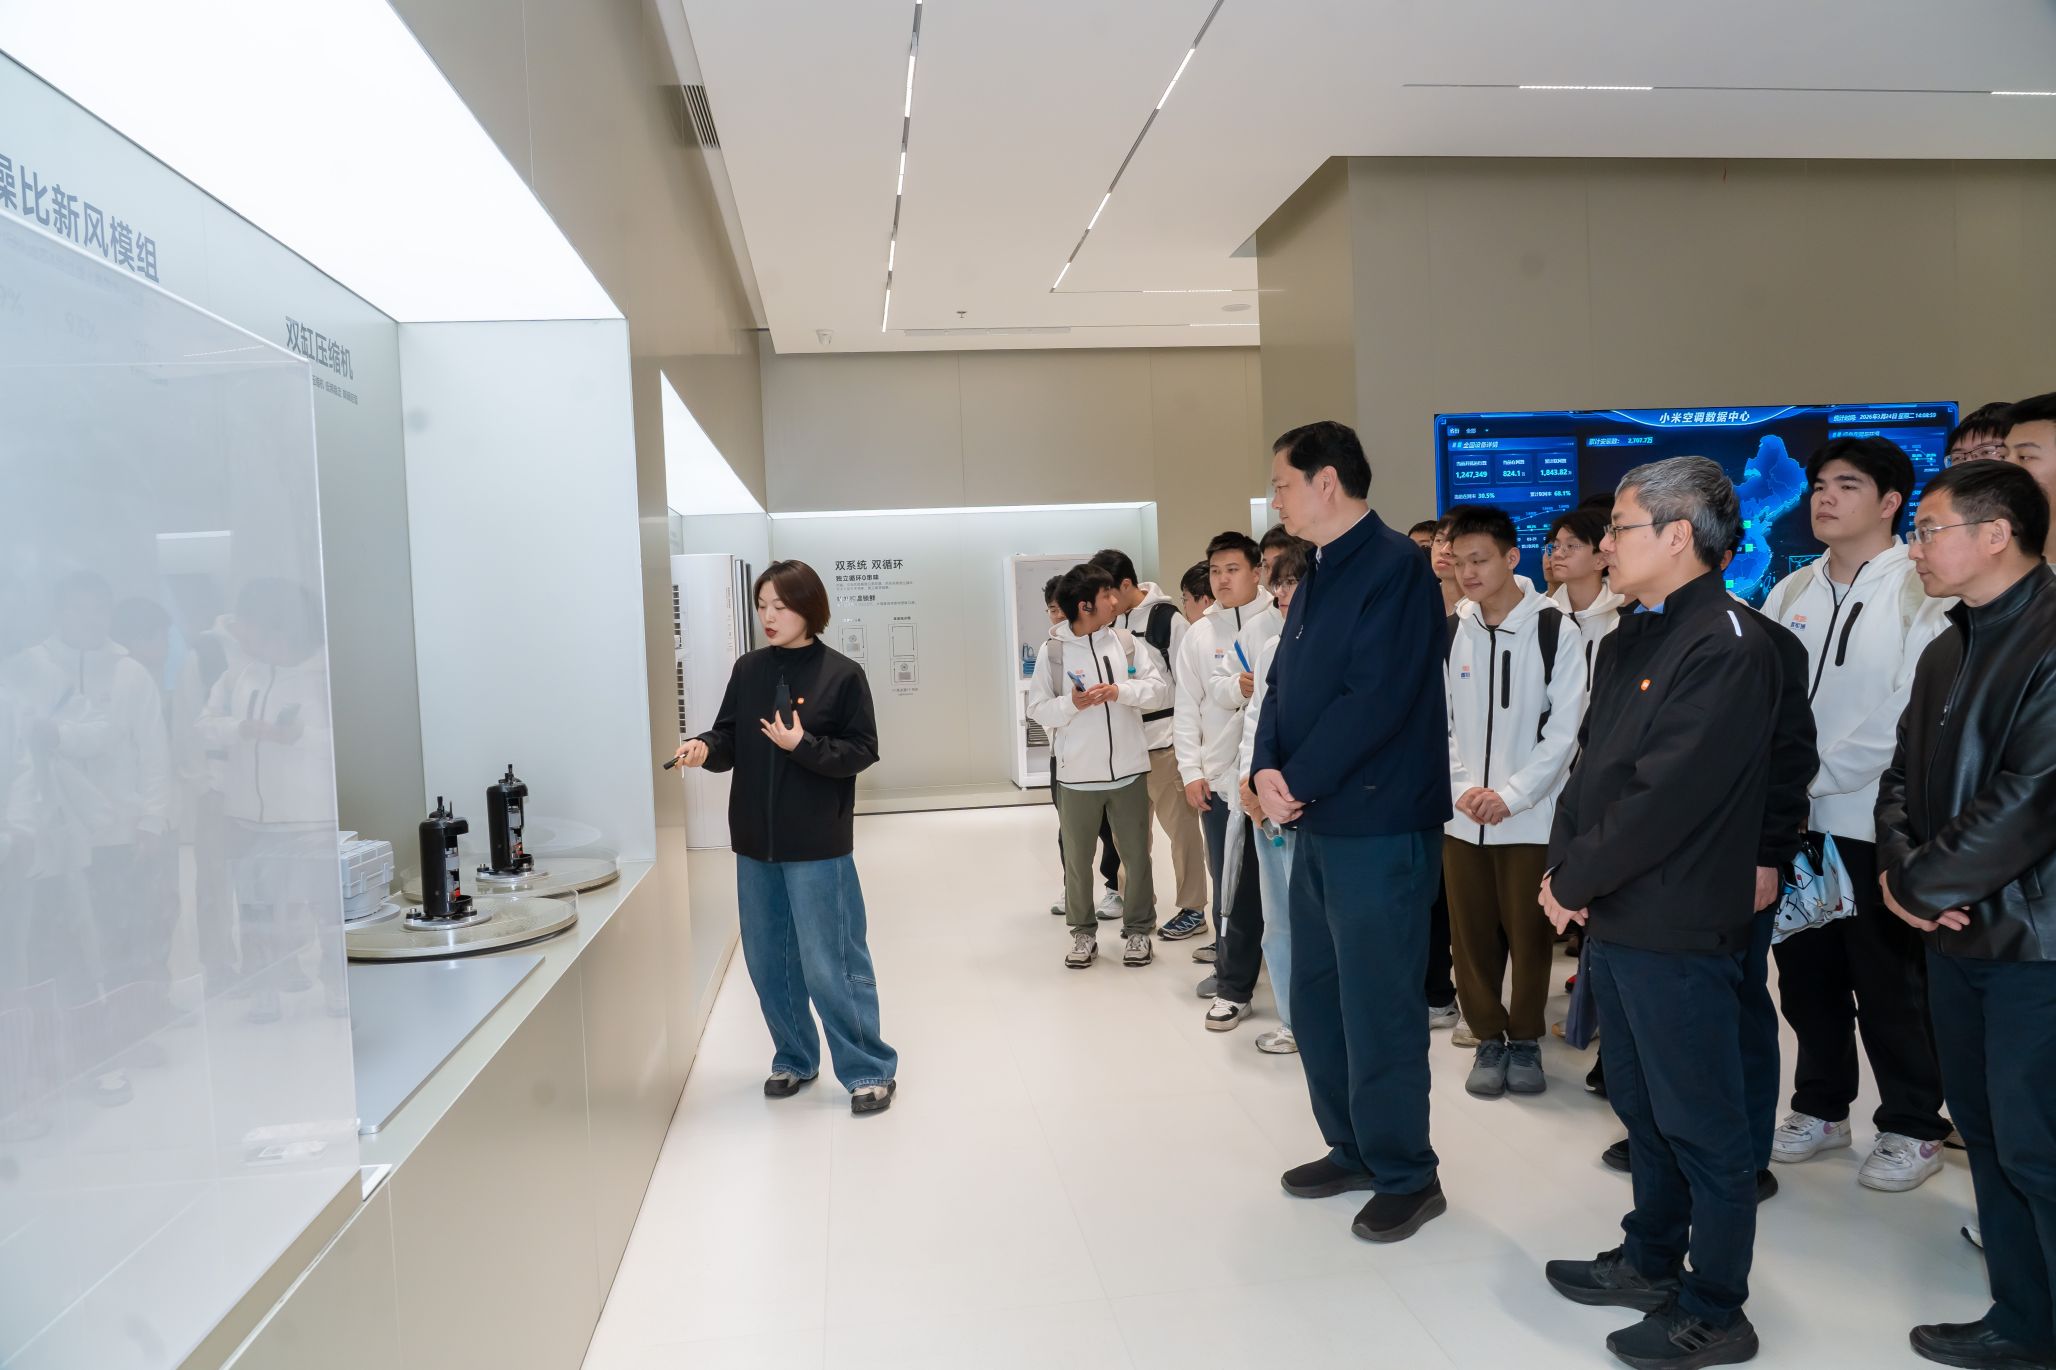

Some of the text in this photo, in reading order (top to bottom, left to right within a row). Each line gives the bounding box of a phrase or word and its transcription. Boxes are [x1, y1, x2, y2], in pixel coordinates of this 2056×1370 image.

[285, 315, 353, 380] 双缸压缩机
[1659, 410, 1750, 424] 小米空调数据中心
[1455, 471, 1488, 479] 1,247,349
[1540, 468, 1568, 476] 1,843.82
[835, 559, 904, 571] 双系统 双循环
